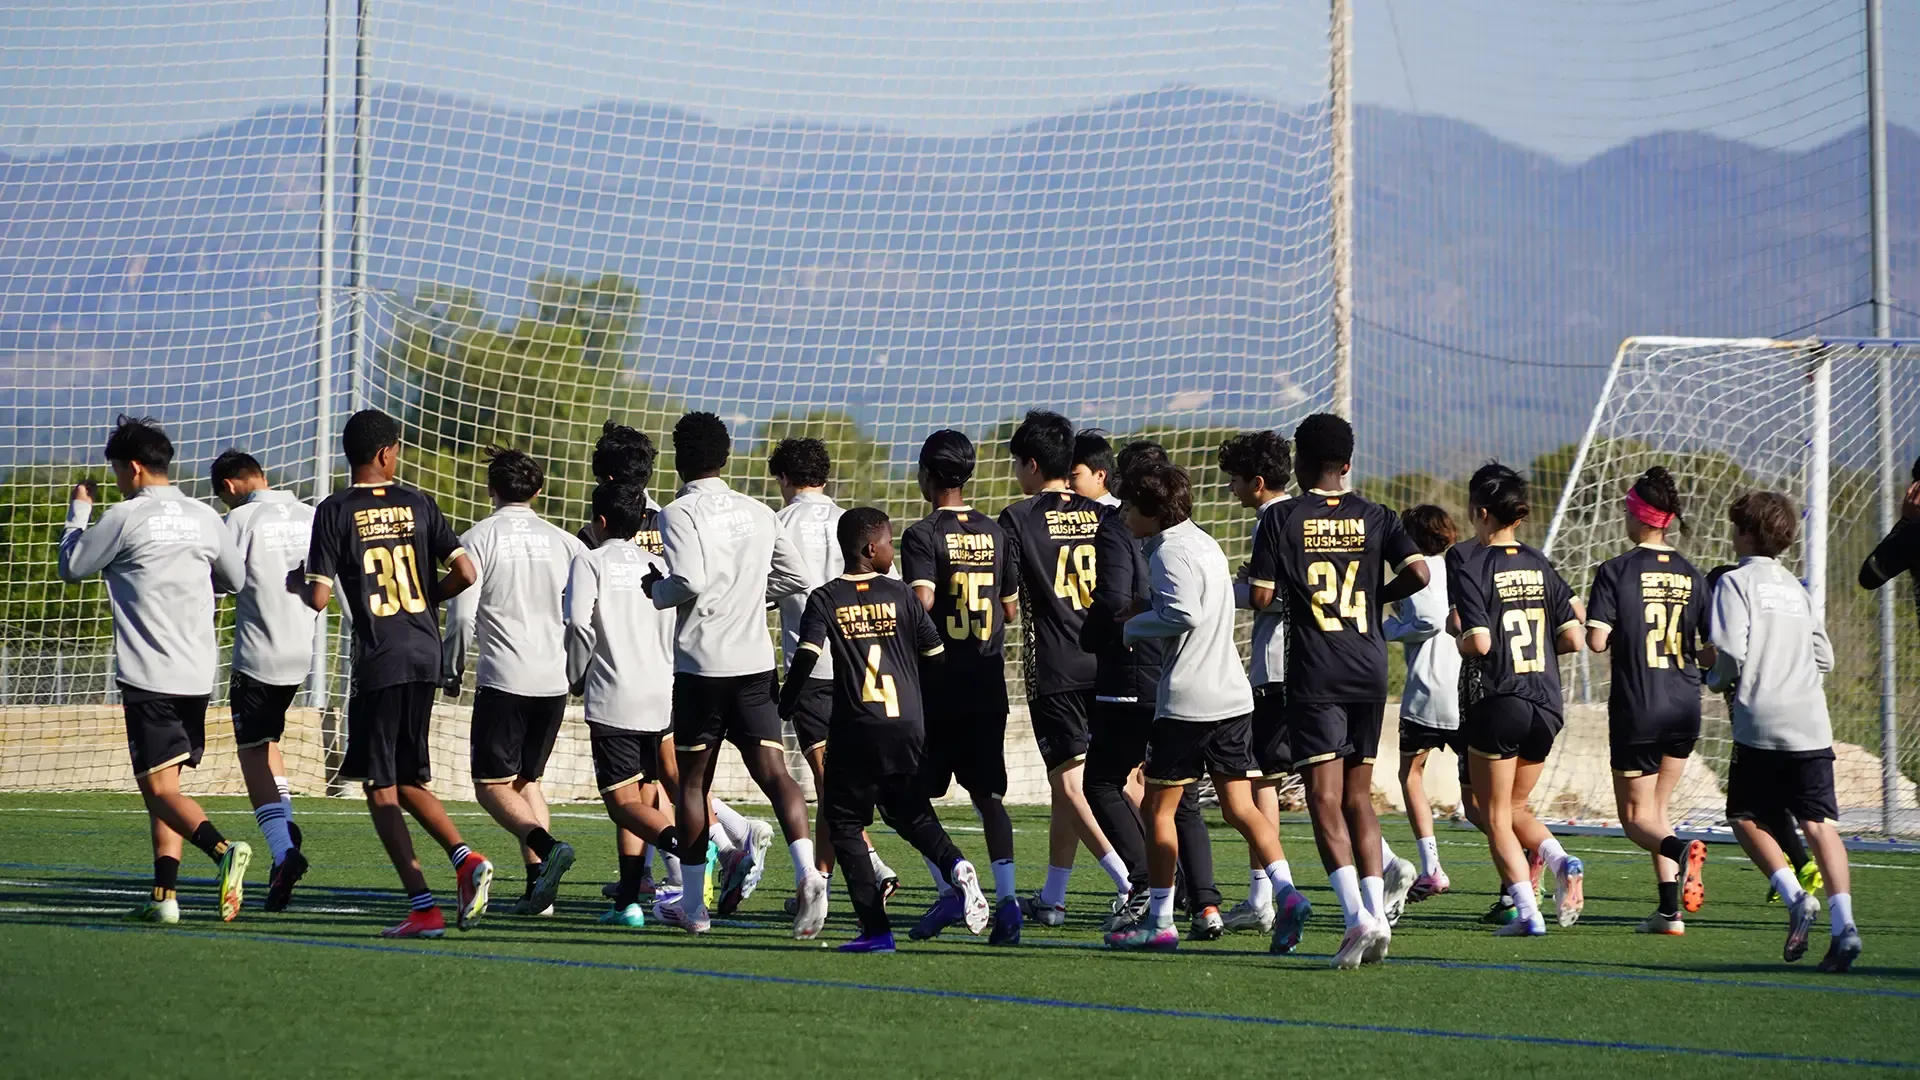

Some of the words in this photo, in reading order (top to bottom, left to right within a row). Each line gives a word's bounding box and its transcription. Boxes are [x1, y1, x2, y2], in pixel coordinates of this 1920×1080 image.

[147, 515, 201, 530] SPAIN
[354, 507, 413, 526] SPAIN
[510, 518, 531, 532] 22
[1045, 510, 1099, 525] SPAIN
[358, 521, 415, 537] RUSH-SPF
[1048, 523, 1100, 536] RUSH-SPF
[1303, 519, 1366, 536] SPAIN
[499, 534, 551, 549] SPAIN
[945, 533, 995, 550] SPAIN
[1304, 535, 1366, 548] RUSH-SPF
[949, 549, 995, 562] RUSH-SPF
[363, 544, 426, 617] 30
[1494, 570, 1544, 588] SPAIN
[1640, 572, 1692, 590] SPAIN
[1307, 560, 1368, 633] 24
[1498, 586, 1545, 599] RUSH-SPF
[836, 603, 896, 623] SPAIN
[946, 571, 994, 641] 35
[841, 620, 897, 634] RUSH-SPF
[1644, 602, 1685, 669] 24
[1502, 608, 1546, 674] 27
[862, 644, 900, 718] 4
